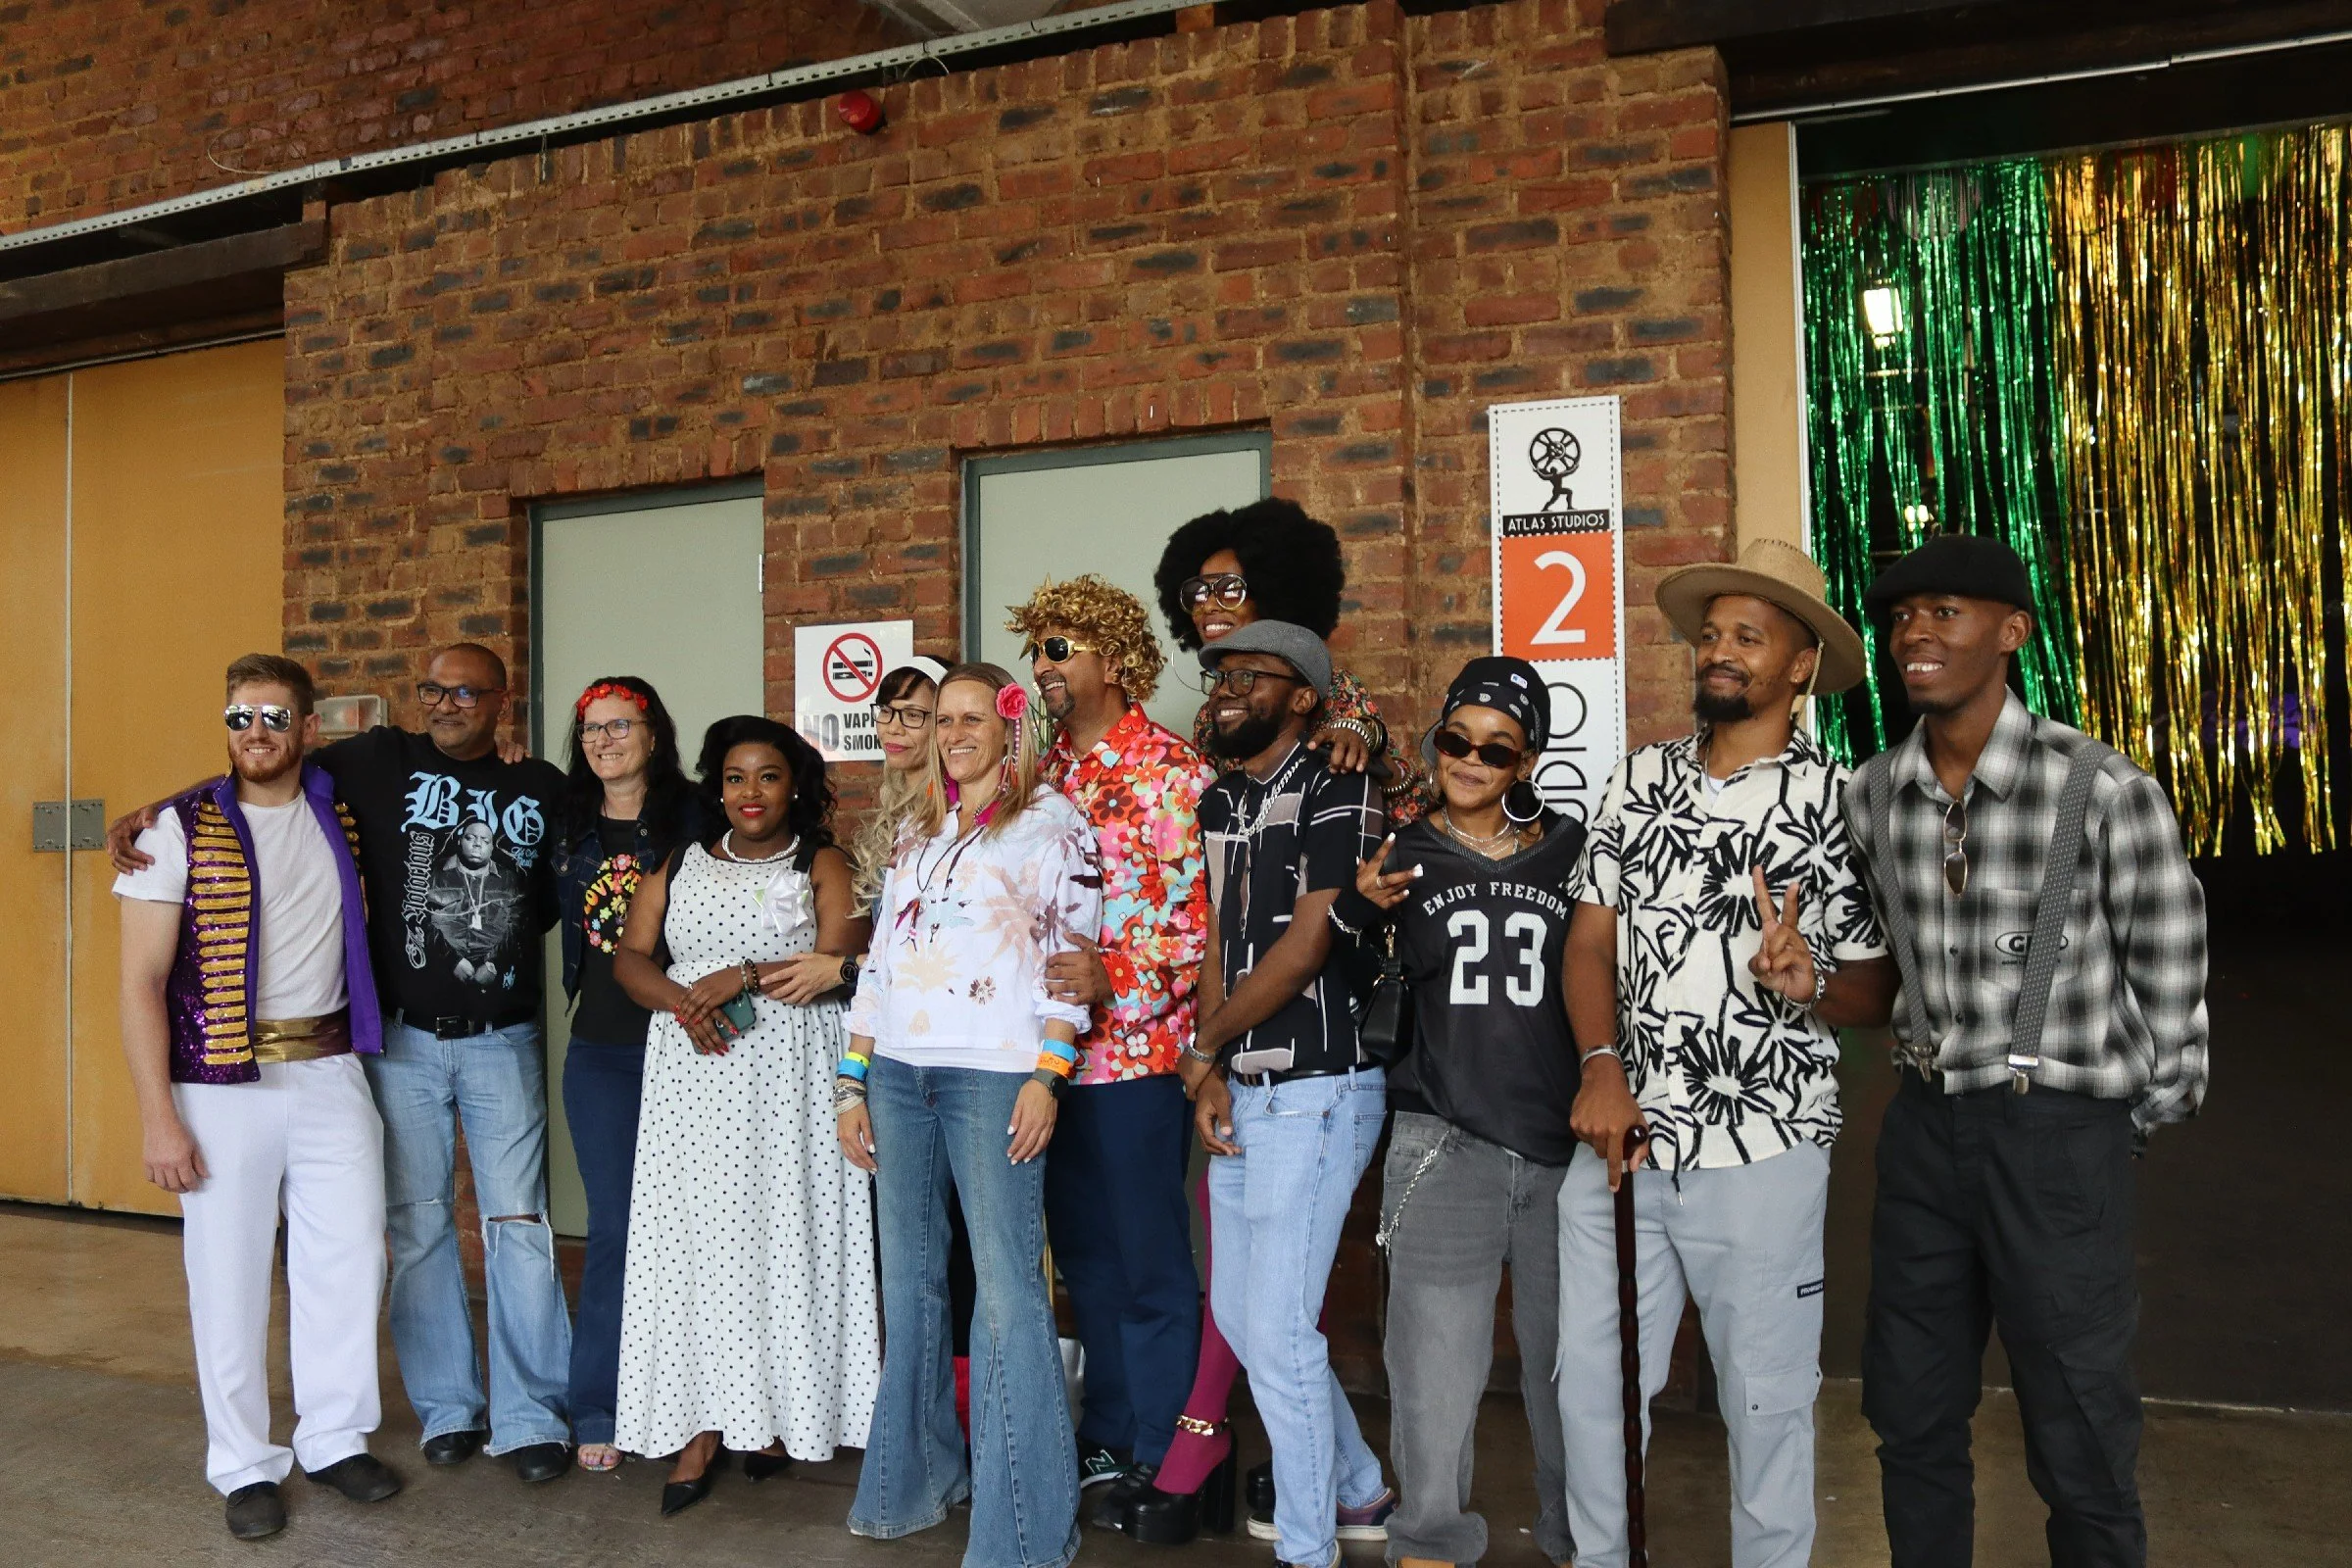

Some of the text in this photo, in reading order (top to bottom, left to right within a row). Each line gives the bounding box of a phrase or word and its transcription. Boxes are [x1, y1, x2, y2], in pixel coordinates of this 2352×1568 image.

[1508, 513, 1605, 531] ATLAS STUDIOS
[1530, 550, 1587, 645] 2
[803, 713, 840, 752] NO
[401, 830, 435, 925] Notorious
[1422, 881, 1568, 920] ENJOY FREEDOM
[1446, 909, 1548, 1007] 23
